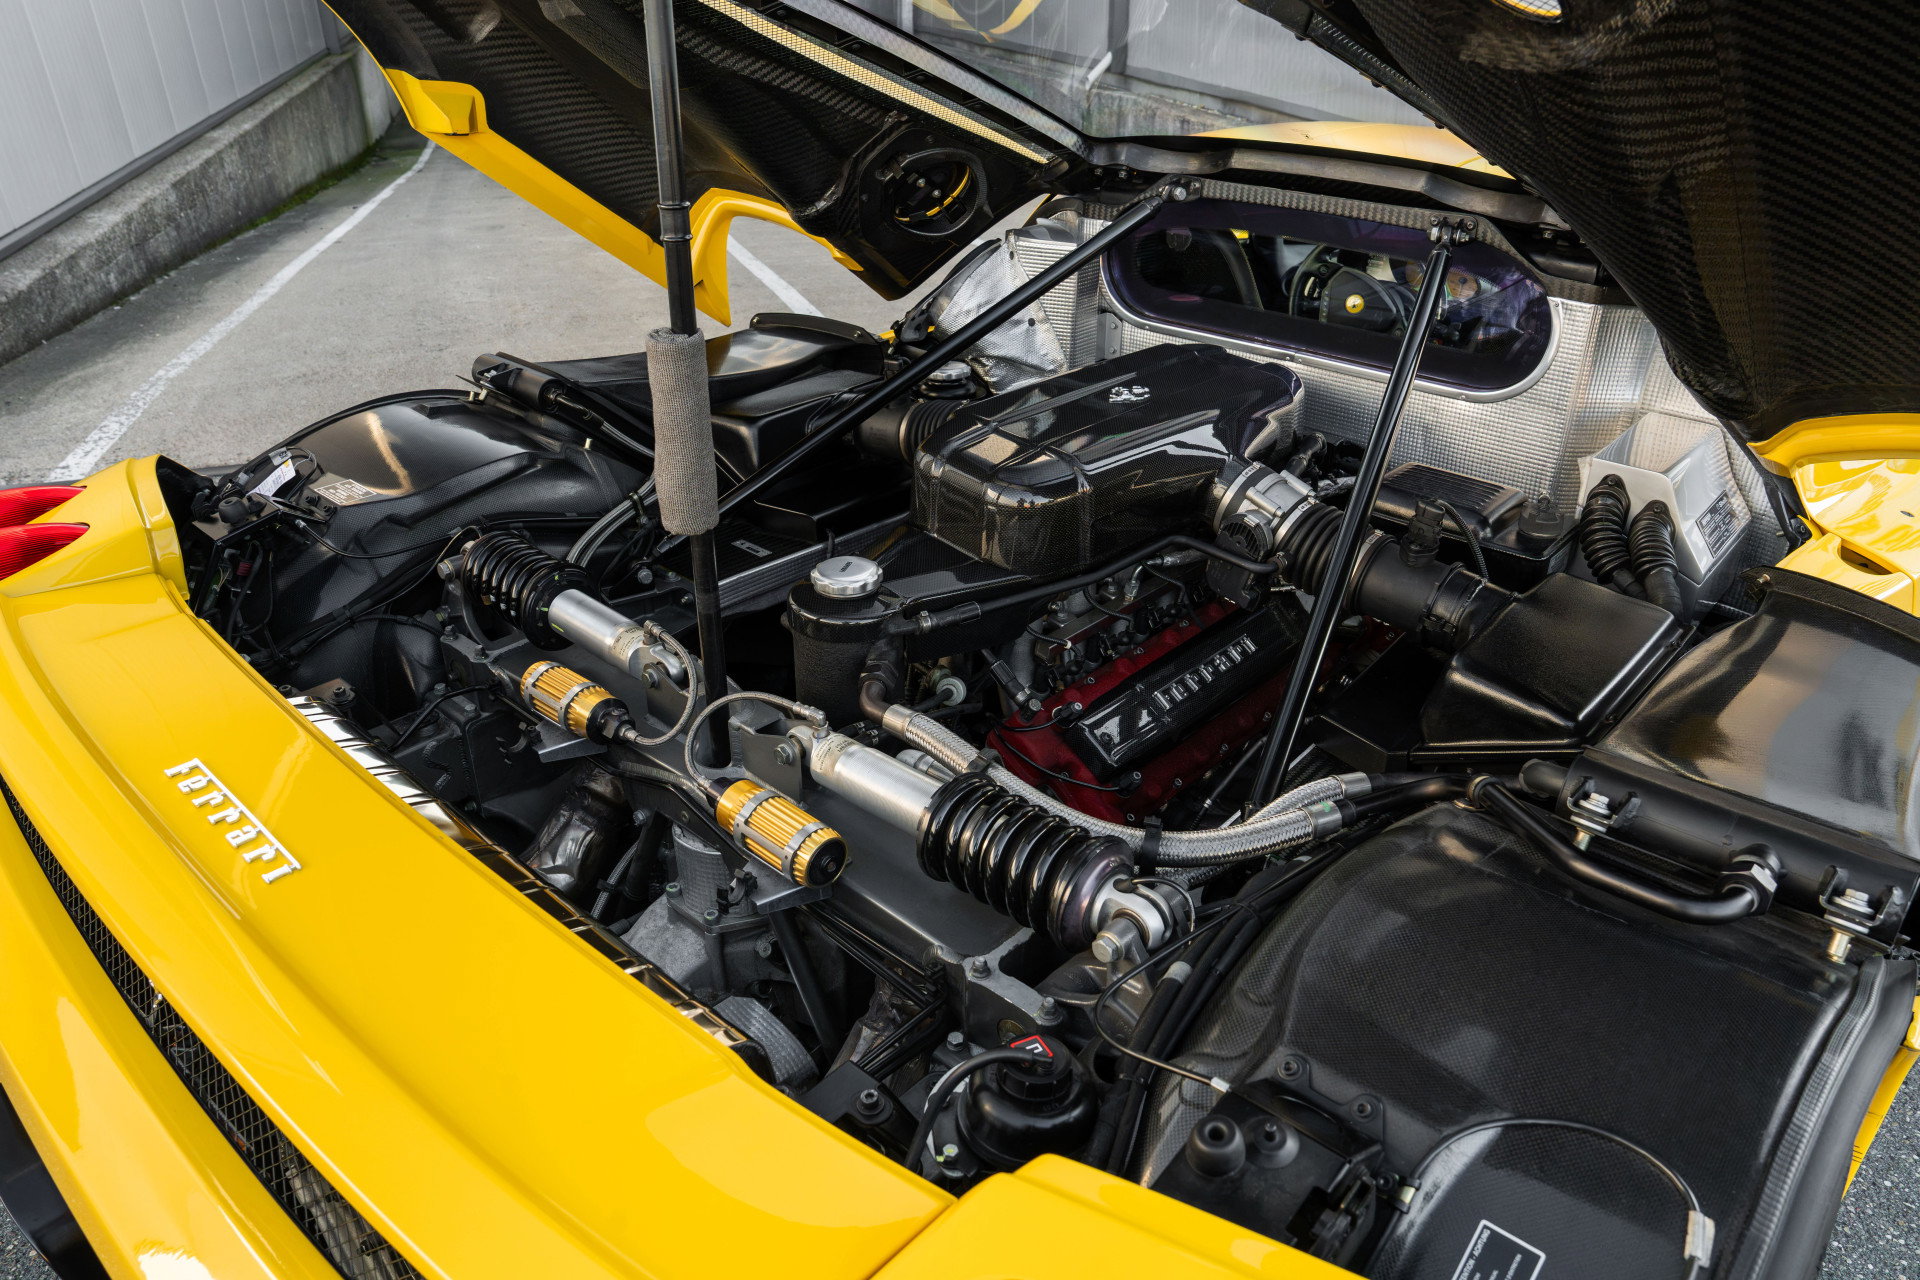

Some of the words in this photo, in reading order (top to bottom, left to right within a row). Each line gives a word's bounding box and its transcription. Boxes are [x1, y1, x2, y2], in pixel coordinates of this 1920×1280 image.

[1152, 633, 1258, 711] Ferrari
[163, 757, 302, 884] Ferrari
[1472, 1228, 1491, 1257] ACHTUNG
